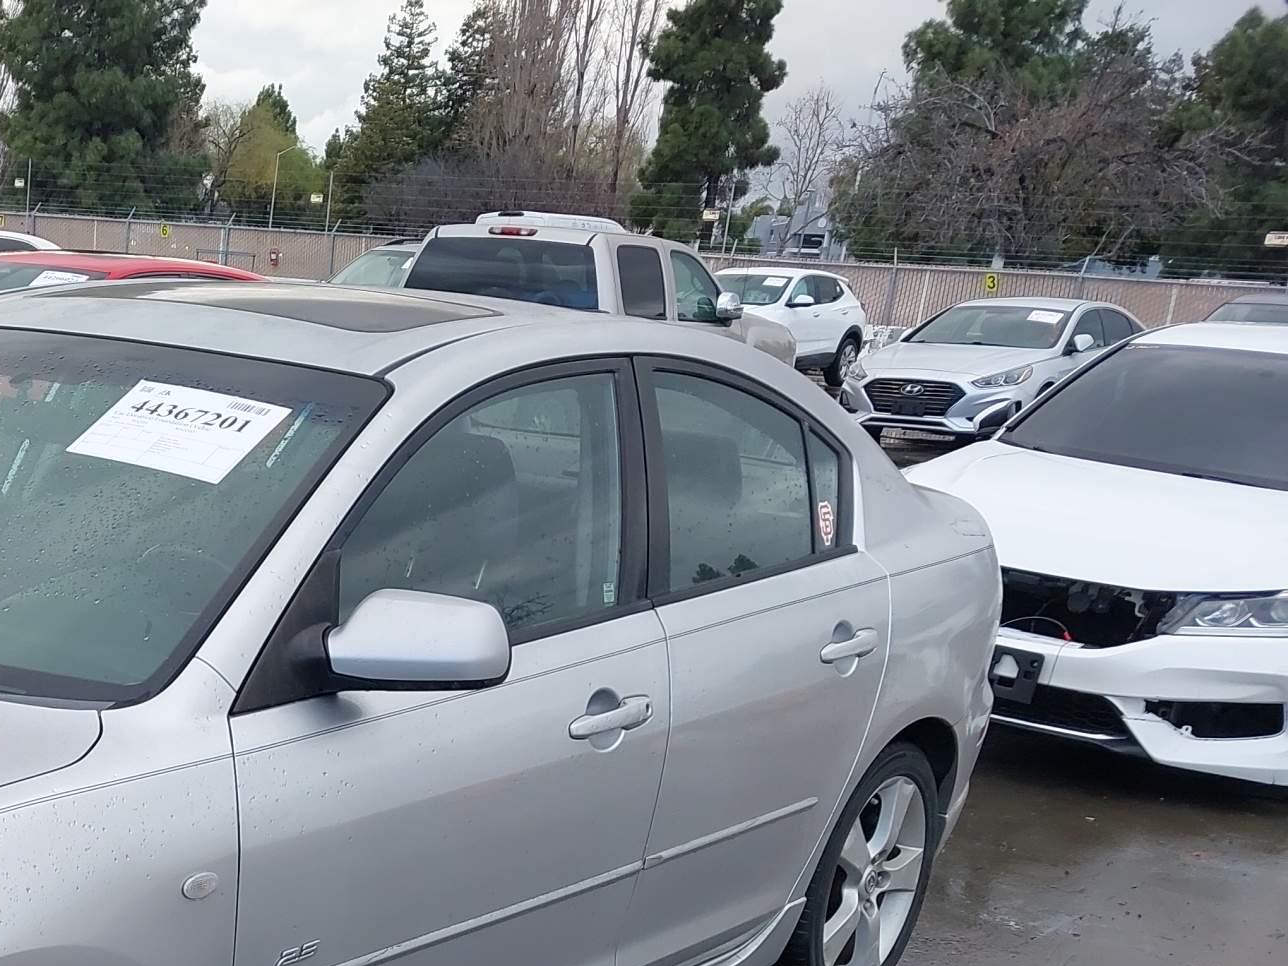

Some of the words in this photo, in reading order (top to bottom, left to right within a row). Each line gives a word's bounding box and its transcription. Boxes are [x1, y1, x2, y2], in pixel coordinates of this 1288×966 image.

[162, 225, 169, 237] 6
[987, 275, 996, 290] 3
[130, 399, 252, 433] 44367201
